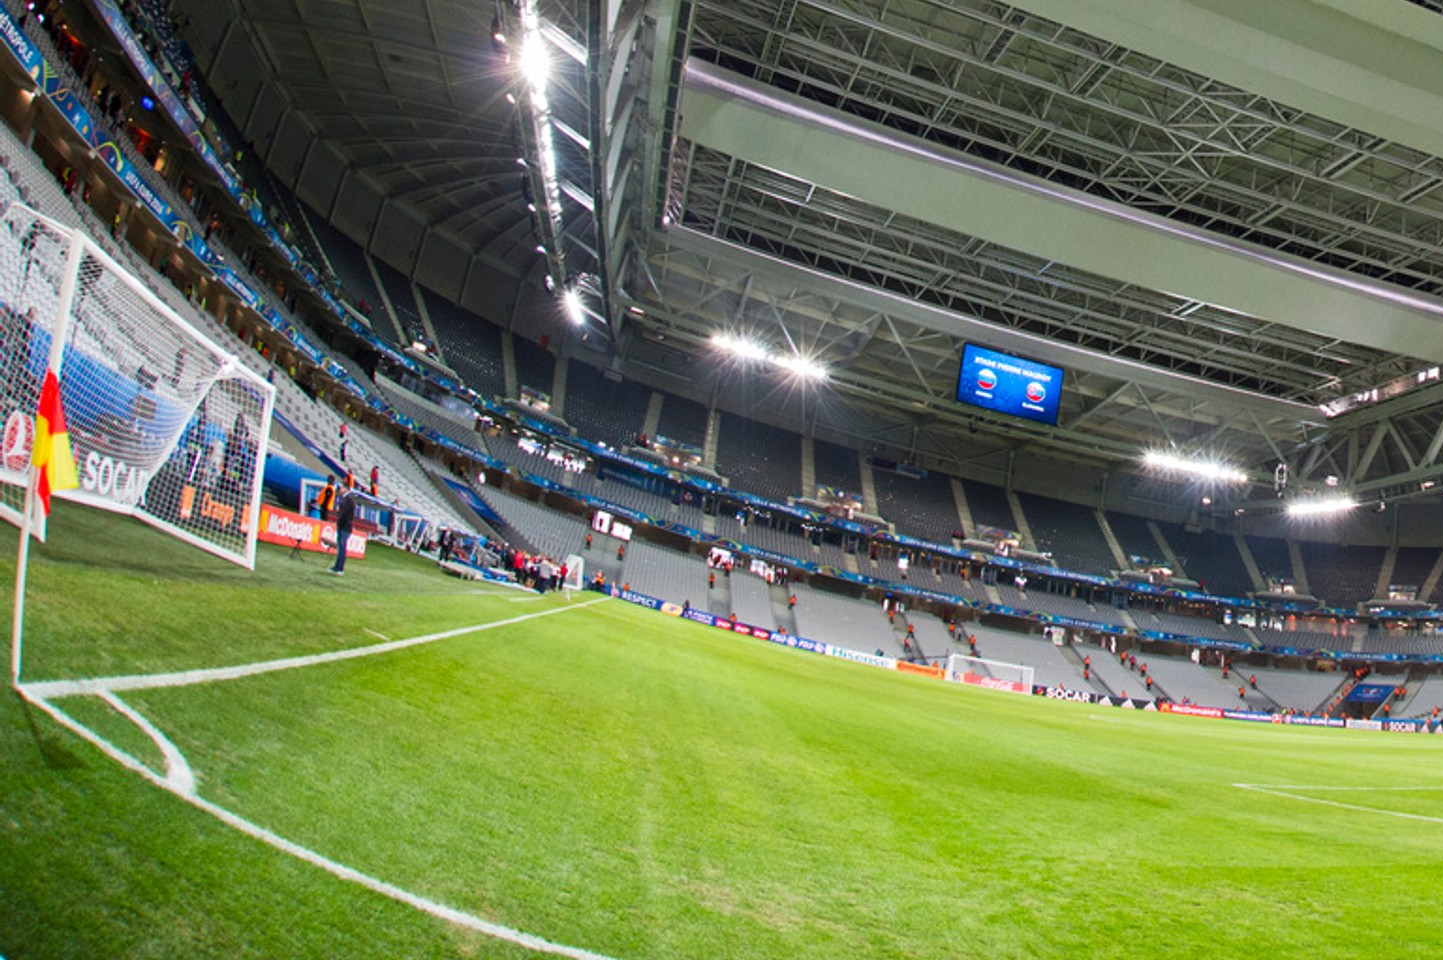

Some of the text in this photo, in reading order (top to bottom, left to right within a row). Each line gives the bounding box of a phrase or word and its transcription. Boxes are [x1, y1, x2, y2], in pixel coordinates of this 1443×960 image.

[622, 591, 657, 609] RESPECT
[832, 647, 890, 669] Hisense
[1046, 687, 1091, 703] SOCAR
[1172, 704, 1222, 718] McDonald's
[1390, 721, 1416, 732] SOCAR
